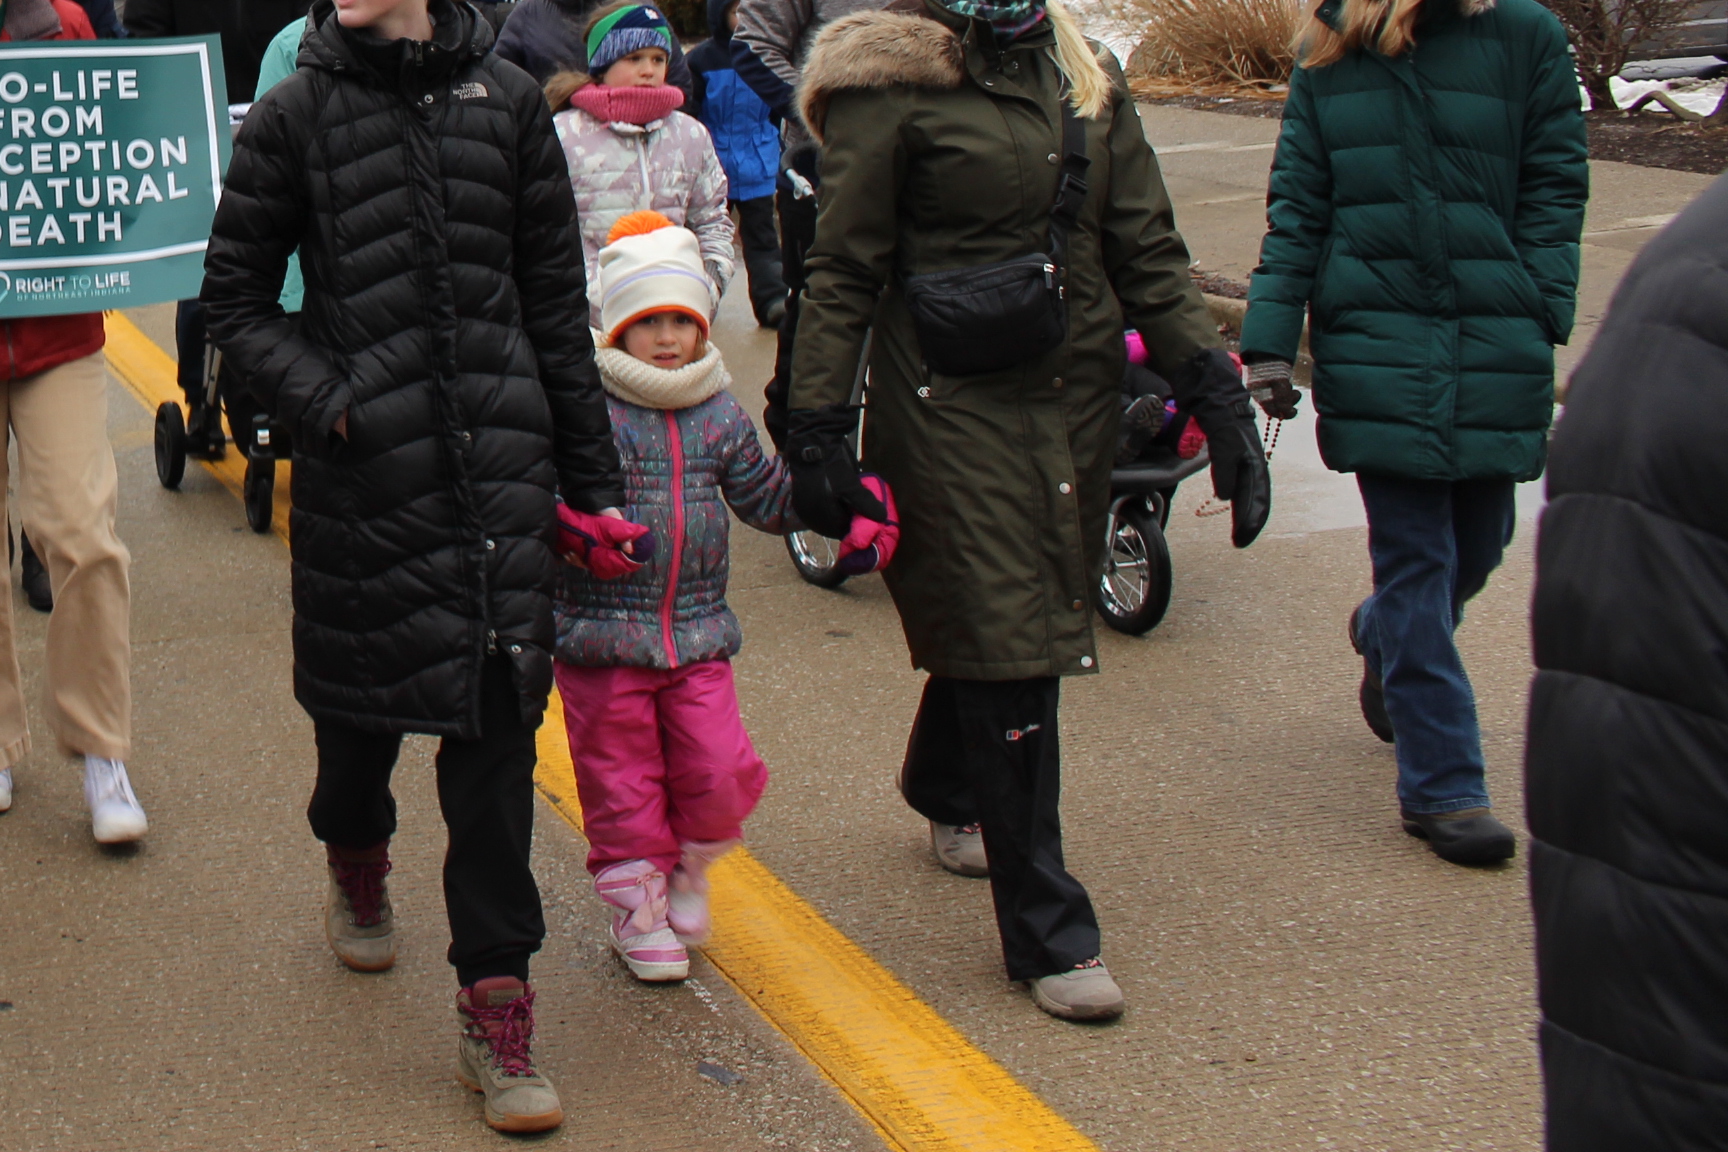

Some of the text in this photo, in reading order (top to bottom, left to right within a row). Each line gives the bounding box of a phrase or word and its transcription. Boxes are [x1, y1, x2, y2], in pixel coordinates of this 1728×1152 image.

[15, 271, 130, 293] RIGHT TO LIFE
[91, 286, 131, 297] INDIANA
